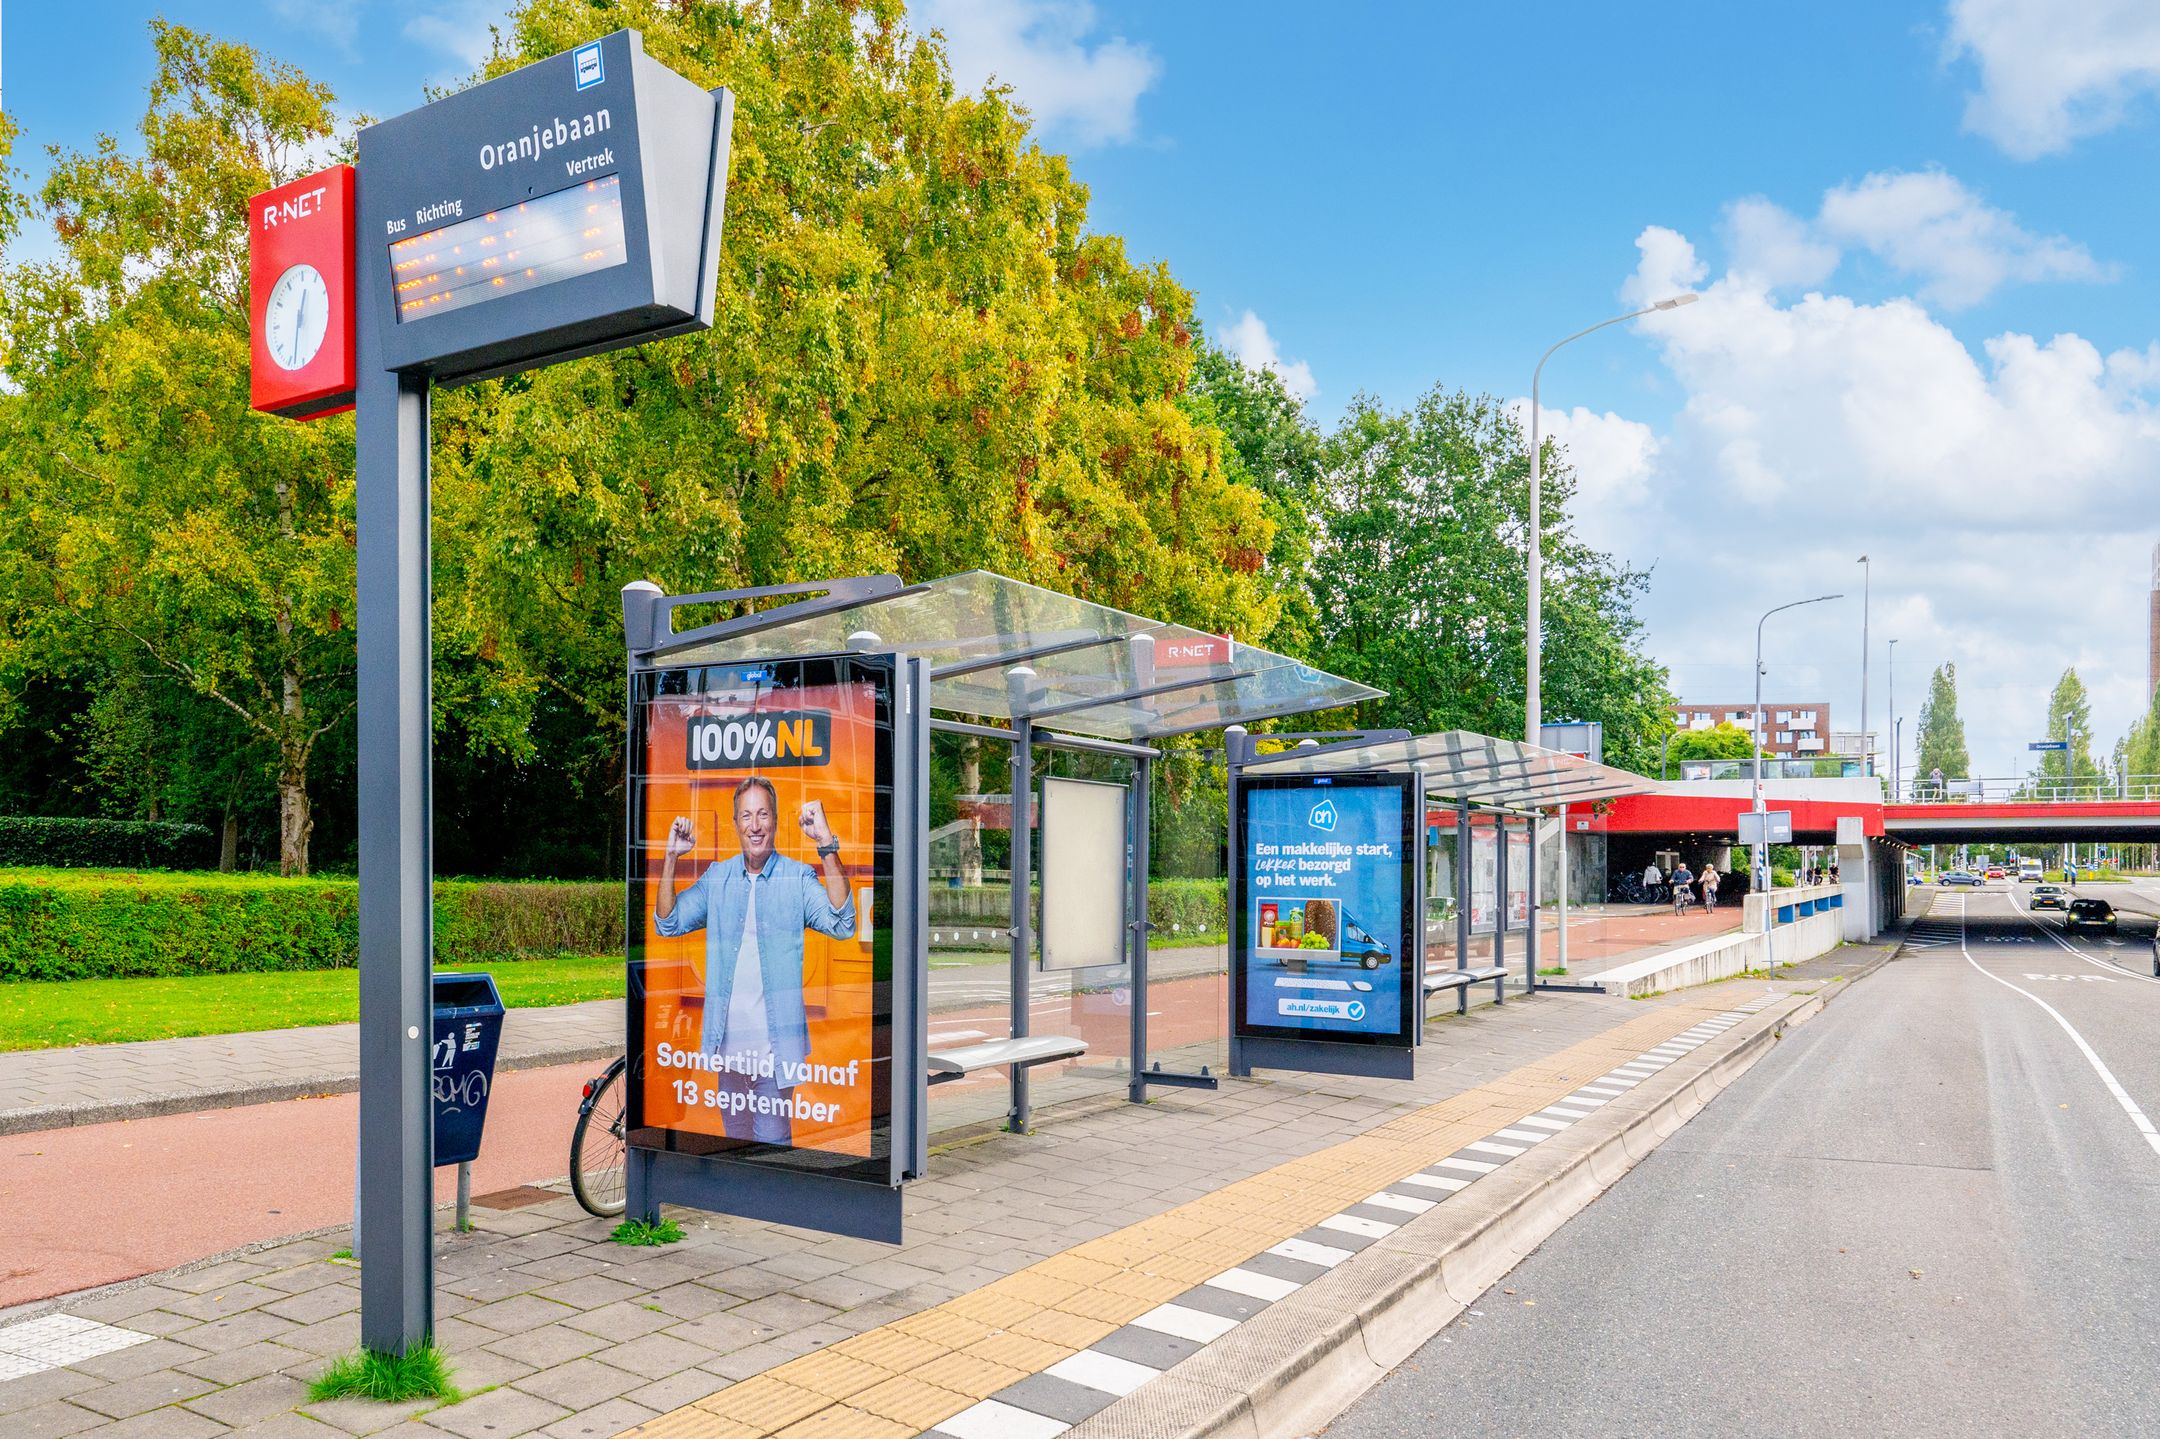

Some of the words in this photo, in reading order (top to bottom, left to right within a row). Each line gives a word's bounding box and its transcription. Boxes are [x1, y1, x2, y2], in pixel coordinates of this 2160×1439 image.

[480, 108, 611, 170] Oranjebaan
[565, 147, 615, 177] Vertrek
[386, 218, 406, 235] Bus
[416, 199, 463, 225] Richting
[1255, 843, 1279, 855] Een
[1282, 842, 1352, 858] makkelijke
[1356, 843, 1393, 858] start,
[1255, 875, 1271, 888] op
[1274, 873, 1296, 886] het
[1299, 873, 1337, 886] werk.
[1298, 858, 1351, 874] bezorgd
[1286, 1003, 1340, 1015] ah.nl/zakelijk
[656, 1042, 775, 1082] Somertijd
[782, 1059, 859, 1087] vanaf
[672, 1080, 699, 1105] 13
[704, 1090, 840, 1123] september
